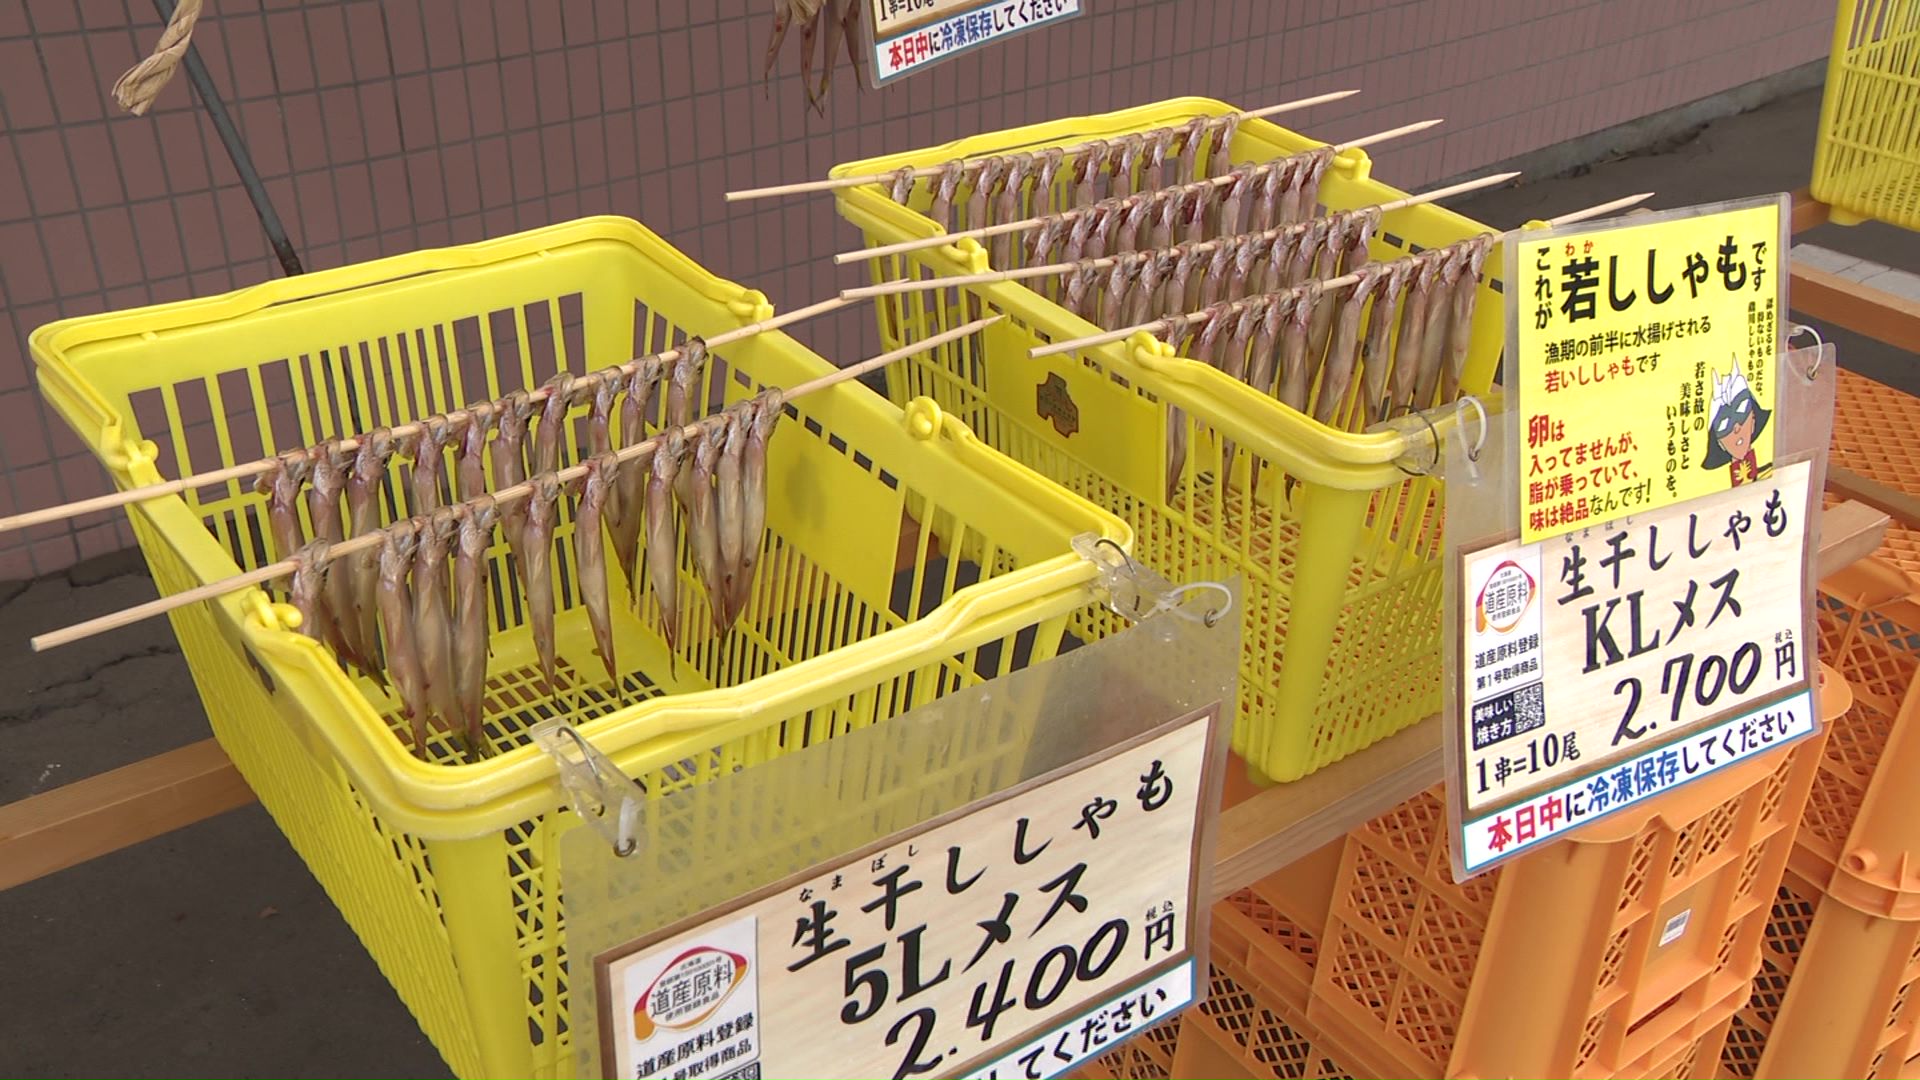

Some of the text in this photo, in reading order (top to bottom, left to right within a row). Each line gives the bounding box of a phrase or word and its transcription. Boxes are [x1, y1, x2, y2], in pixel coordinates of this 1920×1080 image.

[889, 0, 1068, 70] 本日中に冷凍保存してください
[1565, 240, 1594, 256] わか
[1751, 241, 1767, 292] です
[1535, 247, 1552, 330] これが
[1561, 236, 1747, 323] 若ししゃも
[1545, 316, 1711, 365] 漁期の前半に水揚げされる
[1545, 352, 1661, 394] 若いししゃもです
[1692, 361, 1705, 431] 若さ故の
[1528, 414, 1565, 449] 卵は
[1529, 431, 1638, 477] 入ってませんが、
[1680, 382, 1691, 470] 美味しさと
[1529, 460, 1638, 506] 脂が乗っていて、
[1557, 489, 1787, 605] 生干ししゃも
[1475, 633, 1539, 669] 道産原料登録
[1582, 568, 1742, 675] KLメス
[1476, 657, 1538, 690] 第1号取得商品
[1475, 699, 1513, 723] 美味しい
[1476, 718, 1512, 745] 焼き方
[1476, 731, 1581, 794] 1串=10尾
[1487, 708, 1795, 853] 本日中に冷凍保存してください
[786, 760, 1173, 972] 生干ししゃも
[841, 862, 1088, 1025] 5Lメス
[651, 960, 733, 1018] 道産原料
[637, 1011, 754, 1080] 道産原料登録
[661, 1038, 752, 1080] 号取得商品
[983, 988, 1167, 1080] てください
